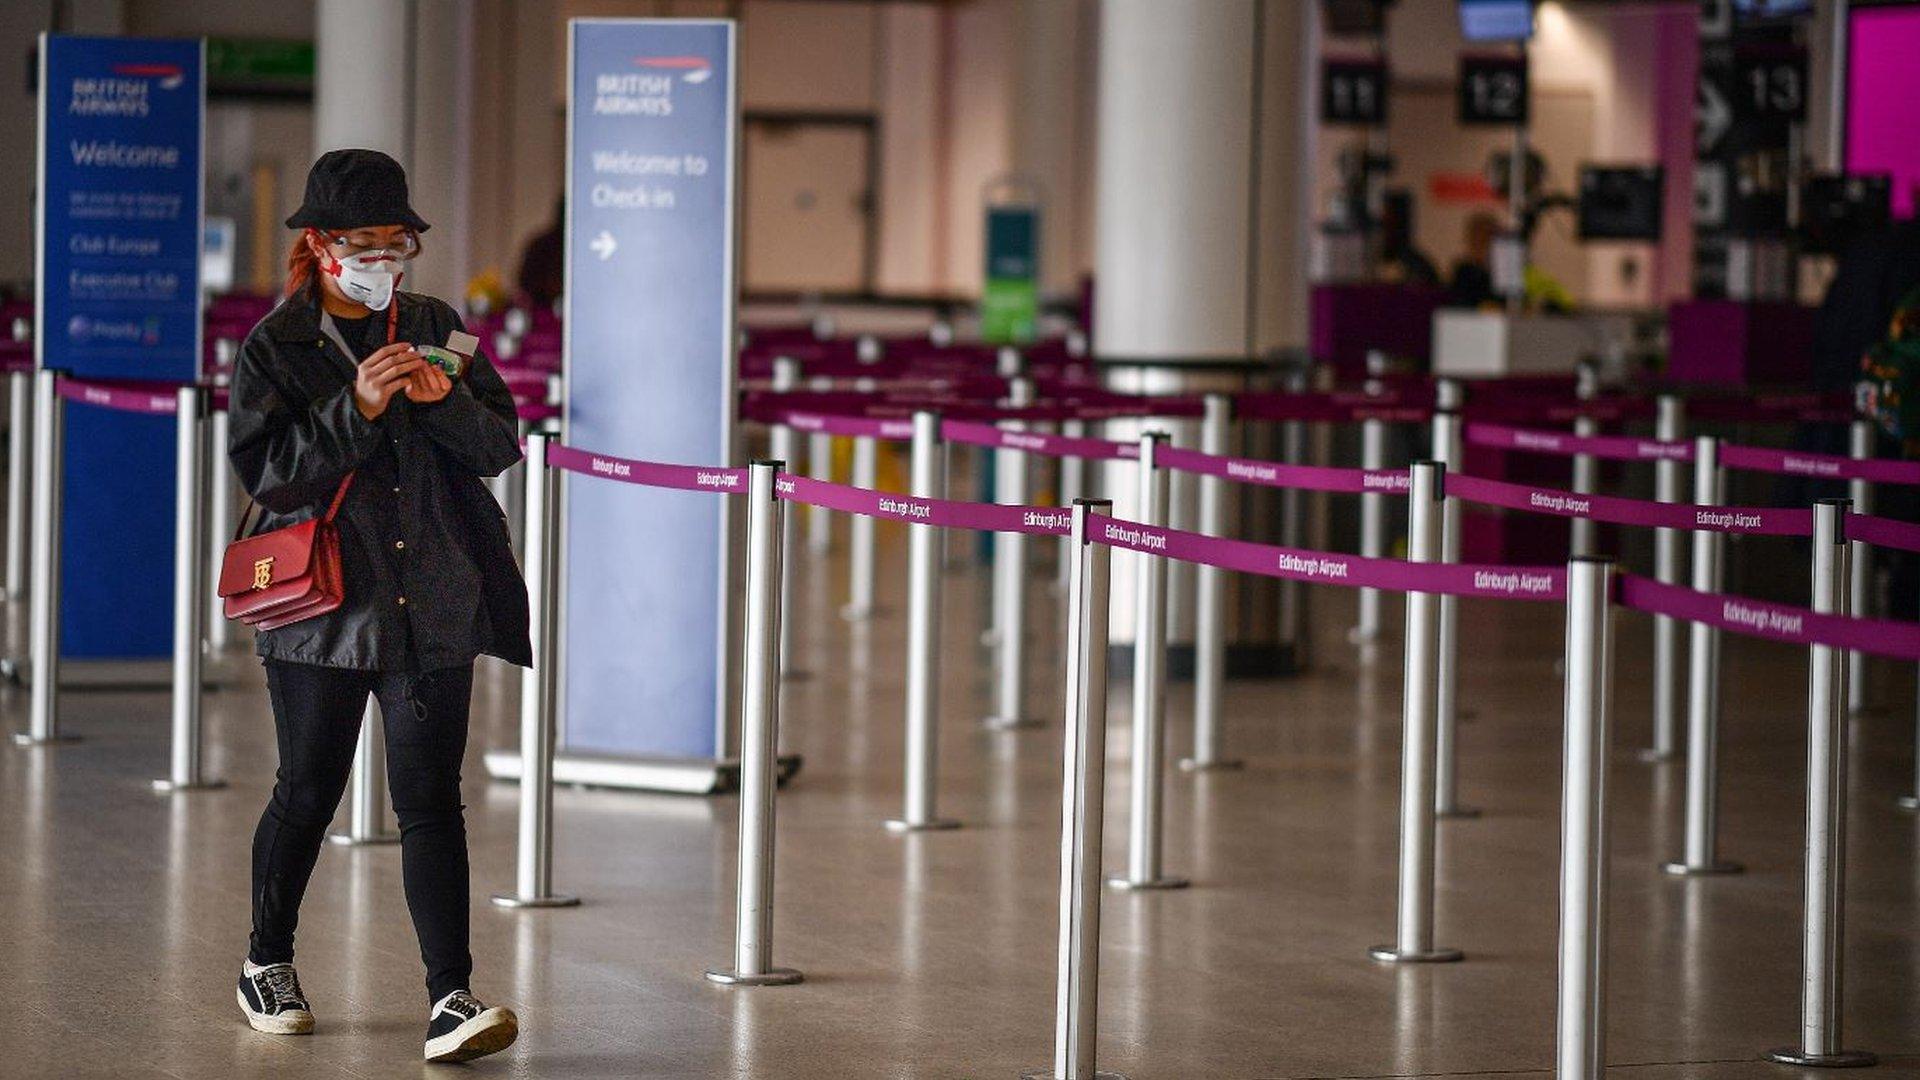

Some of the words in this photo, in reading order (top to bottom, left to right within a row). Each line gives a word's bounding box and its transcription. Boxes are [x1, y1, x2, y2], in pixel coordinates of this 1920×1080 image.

[72, 78, 147, 96] BRITISH
[596, 75, 671, 95] BRITISH
[1472, 73, 1517, 114] 12
[1750, 66, 1799, 110] 13
[70, 97, 148, 116] AIRWAYS
[595, 96, 672, 115] AIRWAYS
[70, 140, 178, 167] Welcome
[593, 151, 680, 175] Welcome
[683, 155, 708, 175] to
[592, 184, 675, 208] Check-in
[1363, 474, 1396, 490] Edinburgh
[878, 498, 910, 517] Edinburgh
[910, 502, 932, 518] Airport
[1530, 492, 1565, 512] Edinburgh
[1565, 497, 1590, 514] Airport
[1024, 512, 1057, 530] Edinburgh
[1697, 511, 1735, 530] Edinburgh
[1735, 515, 1763, 529] Airport
[1105, 524, 1141, 547] Edinburgh
[1141, 531, 1167, 550] Airport
[1279, 553, 1319, 577] Edinburgh
[1319, 558, 1348, 578] Airport
[1474, 570, 1520, 594] Edinburgh
[1520, 574, 1553, 593] Airport
[1723, 601, 1770, 631] Edinburgh
[1770, 609, 1803, 634] Airport
